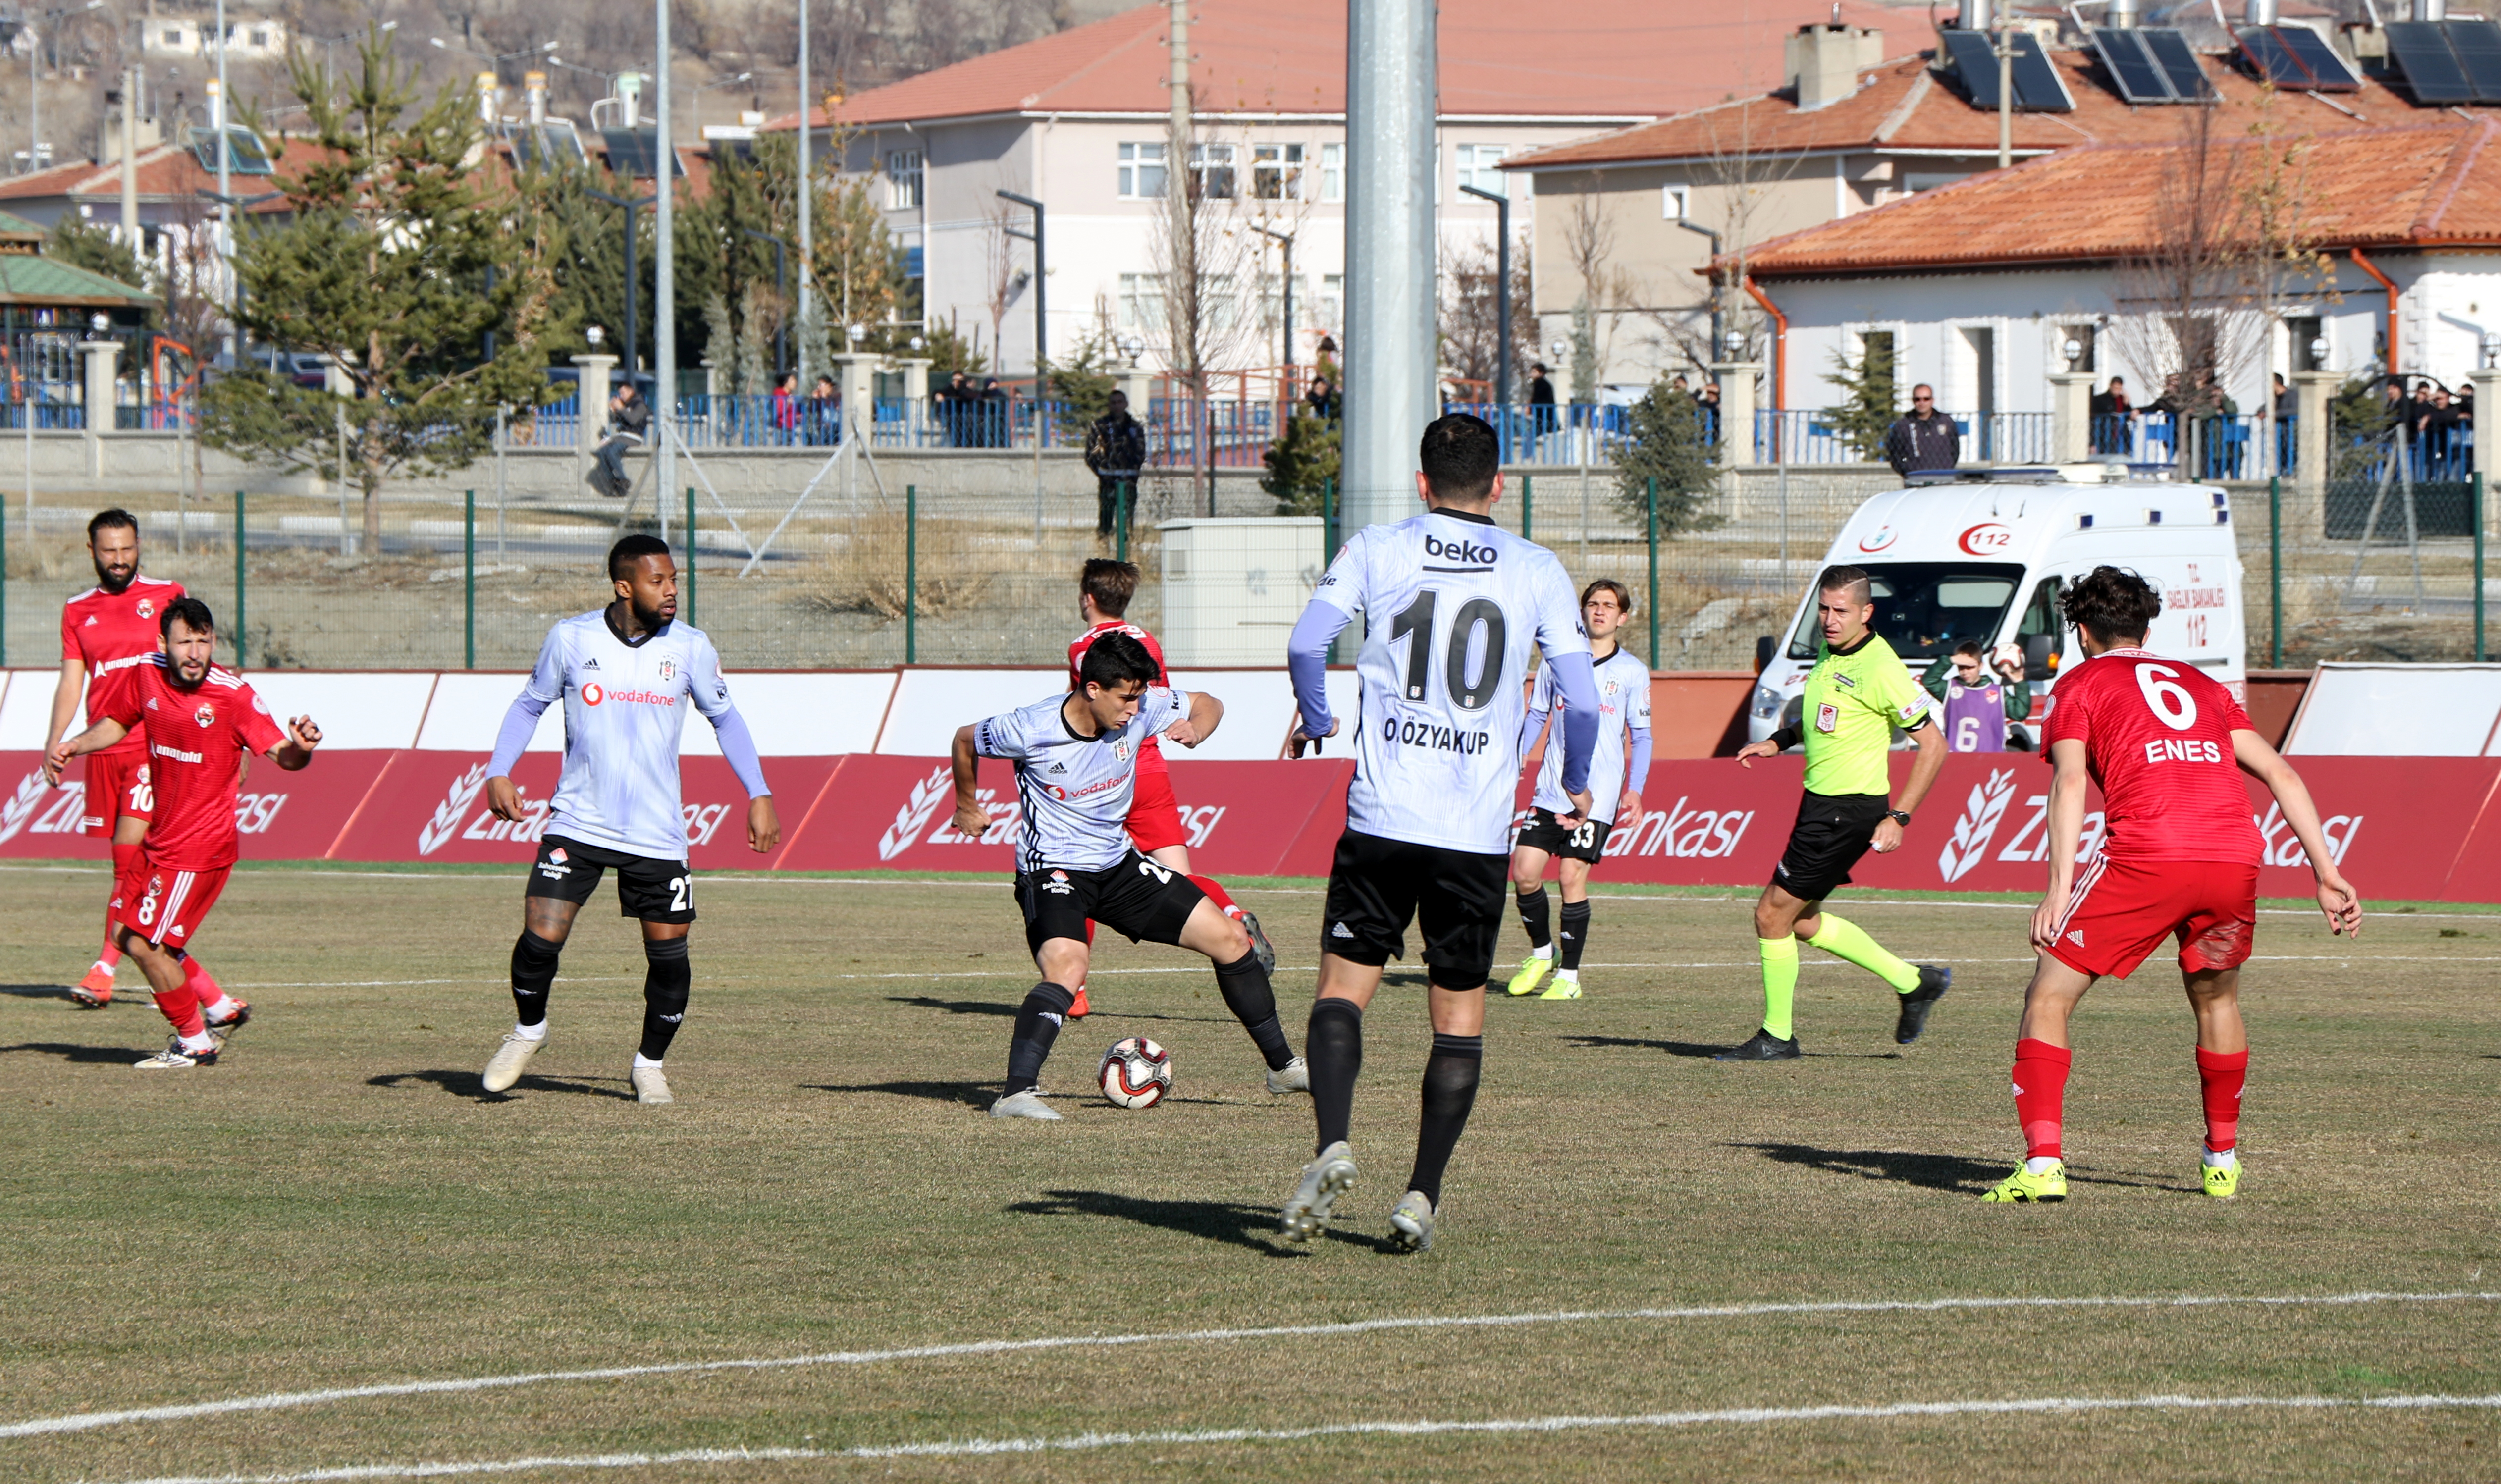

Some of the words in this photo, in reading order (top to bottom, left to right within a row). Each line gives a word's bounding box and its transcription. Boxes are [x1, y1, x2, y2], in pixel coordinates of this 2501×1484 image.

[1425, 534, 1497, 564] beko
[1972, 533, 2011, 546] 112
[2187, 615, 2207, 647] 112
[1388, 587, 1509, 712] 10
[608, 689, 675, 706] vodafone
[2135, 663, 2197, 731] 6
[1384, 716, 1489, 755] O.ÖZYAKUP
[1955, 717, 1980, 752] 6
[2145, 739, 2222, 764] ENES
[129, 784, 154, 812] 10
[1570, 821, 1595, 849] 33
[1600, 795, 1756, 858] ankası
[138, 896, 157, 925] 8
[2066, 933, 2085, 948] adidas
